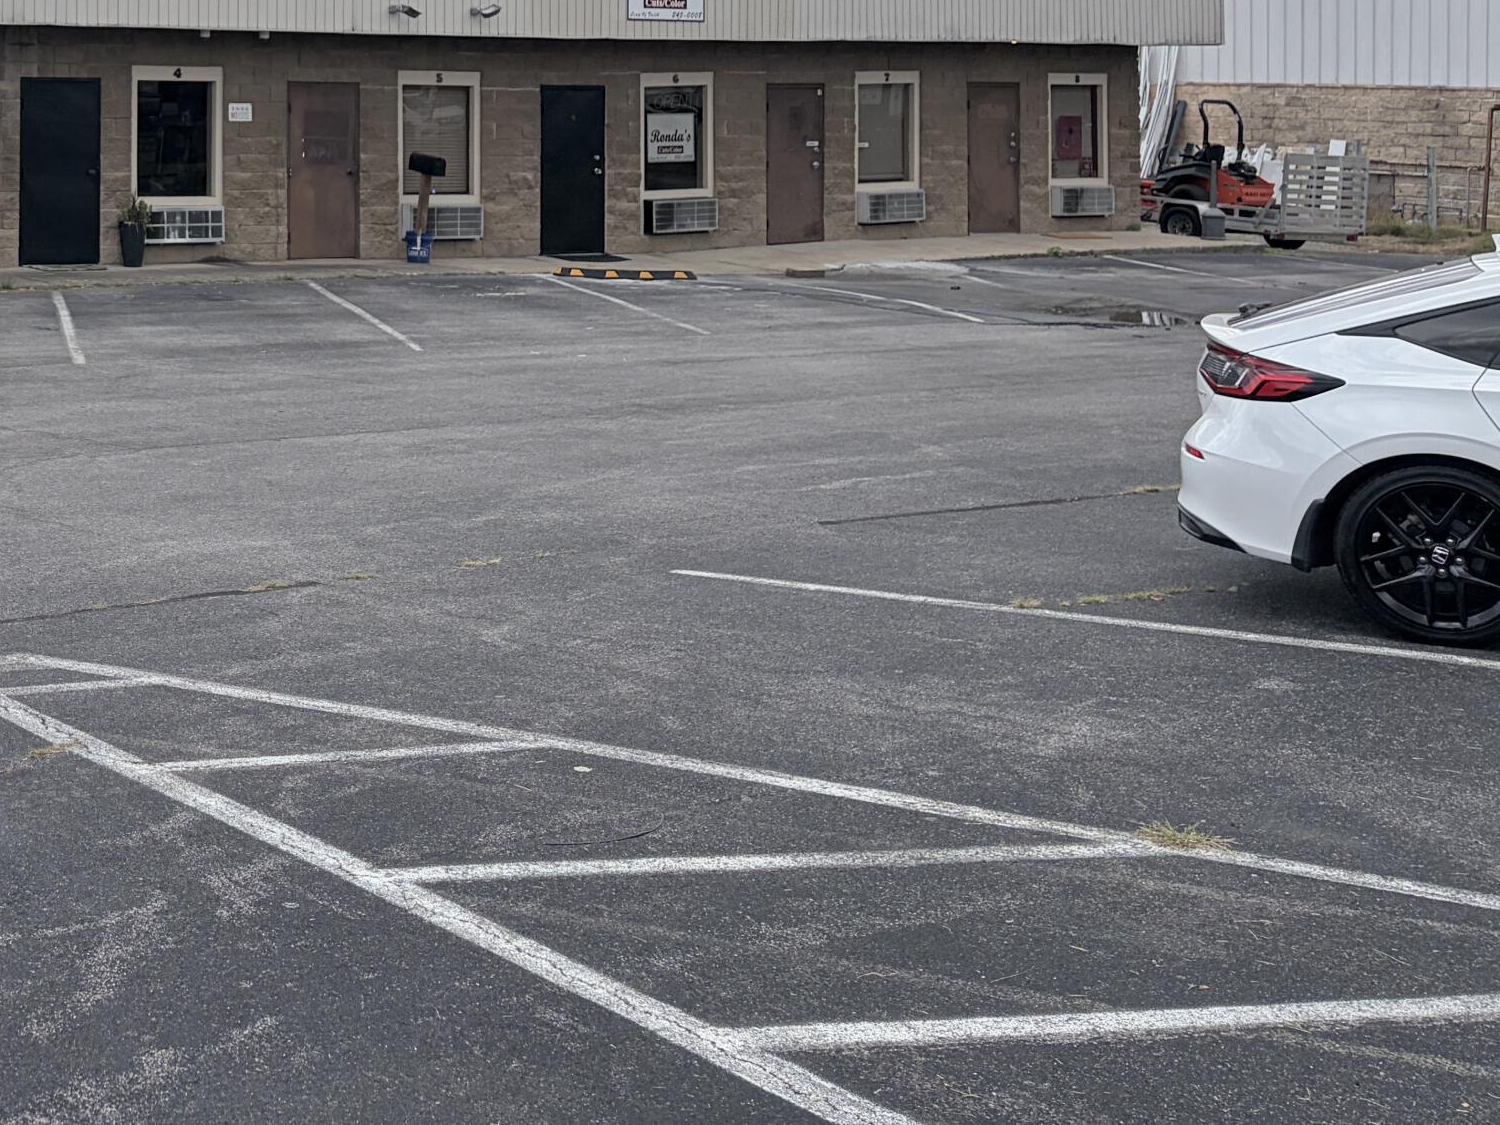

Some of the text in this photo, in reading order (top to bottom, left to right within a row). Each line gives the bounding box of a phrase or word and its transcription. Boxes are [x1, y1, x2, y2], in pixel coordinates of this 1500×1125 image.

[173, 68, 182, 78] 4
[884, 73, 890, 82] 7
[436, 74, 443, 83] 5
[672, 75, 679, 83] 6
[650, 129, 691, 143] Ronda's
